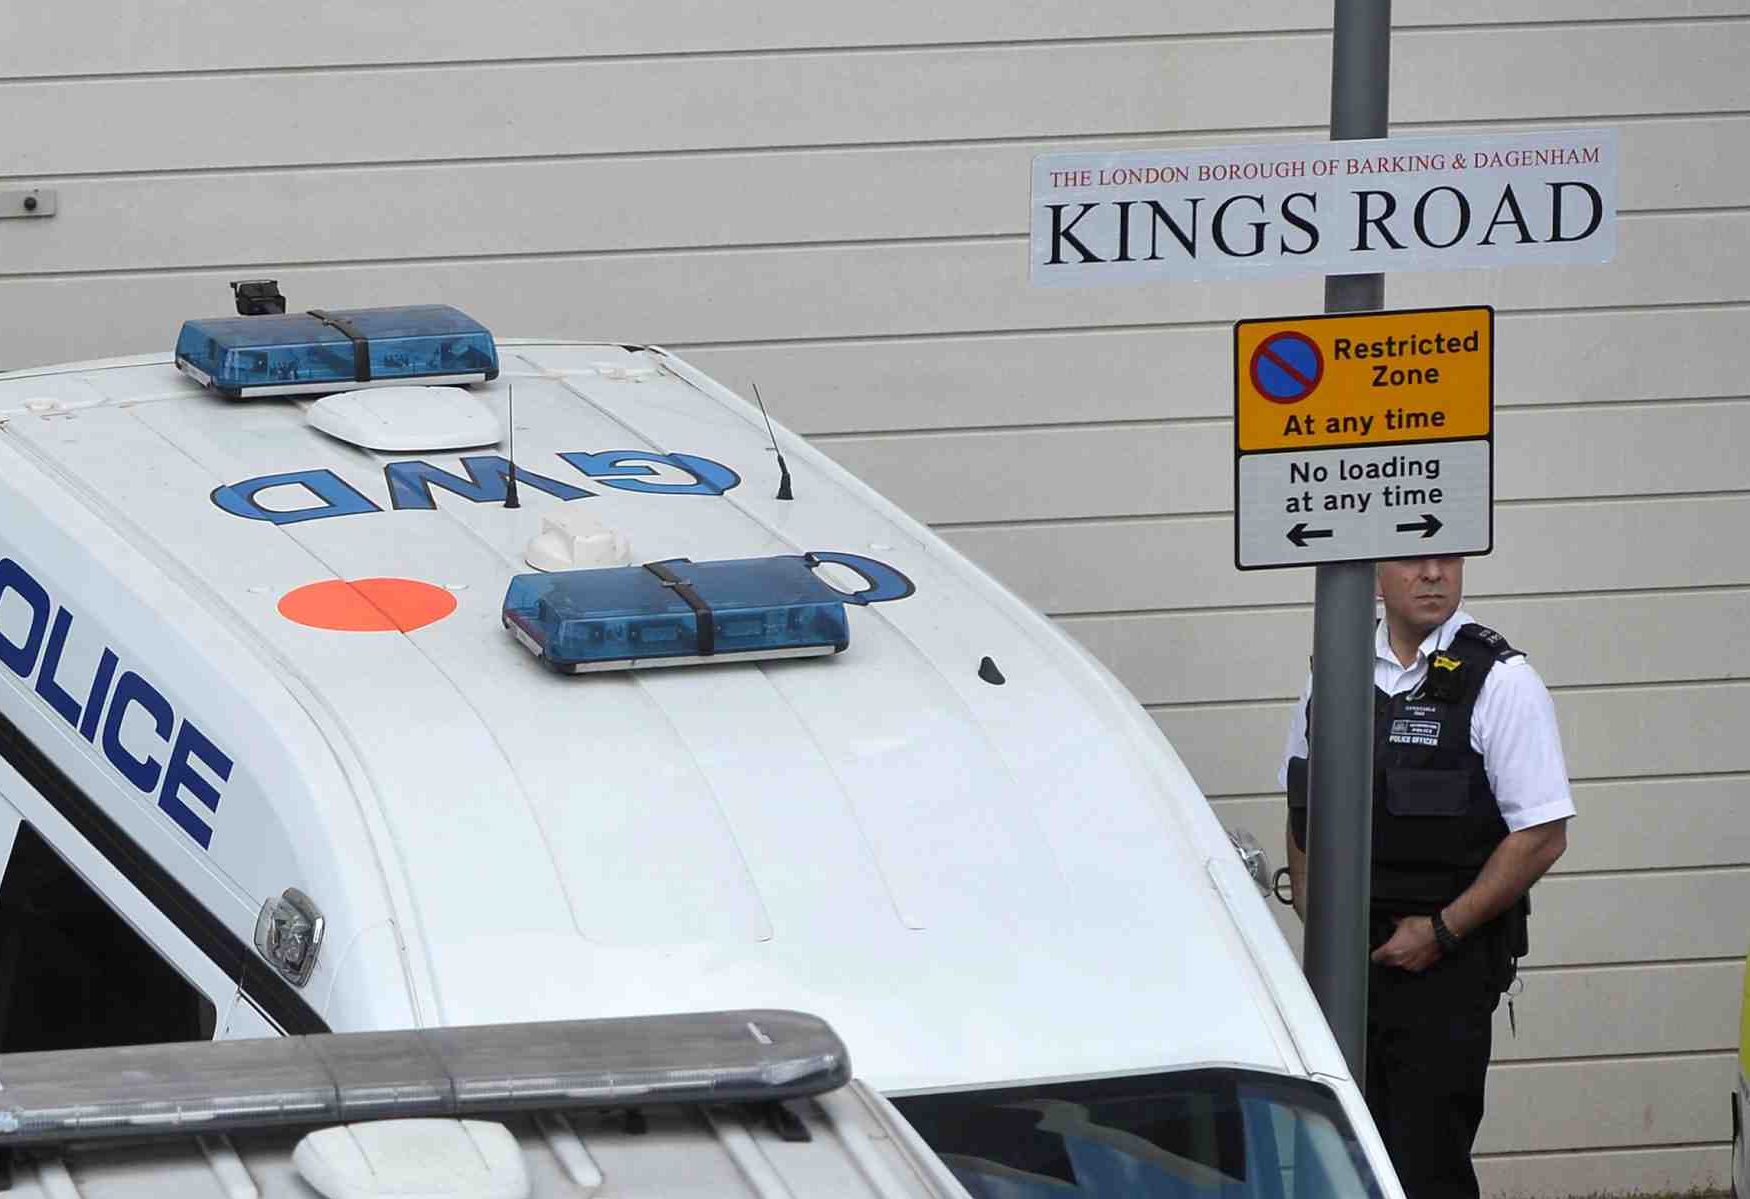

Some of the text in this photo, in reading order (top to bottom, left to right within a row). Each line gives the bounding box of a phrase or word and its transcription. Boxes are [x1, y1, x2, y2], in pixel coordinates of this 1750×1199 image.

[1049, 147, 1600, 188] THE LONDON BOROUGH OF BARKING & DAGENHAM
[1043, 181, 1603, 265] KINGS ROAD
[1334, 330, 1479, 360] Restricted
[1372, 365, 1440, 387] Zone
[1283, 409, 1446, 436] At any time
[1290, 456, 1440, 483] No loading
[210, 449, 742, 525] GWD
[1286, 486, 1443, 513] at any time
